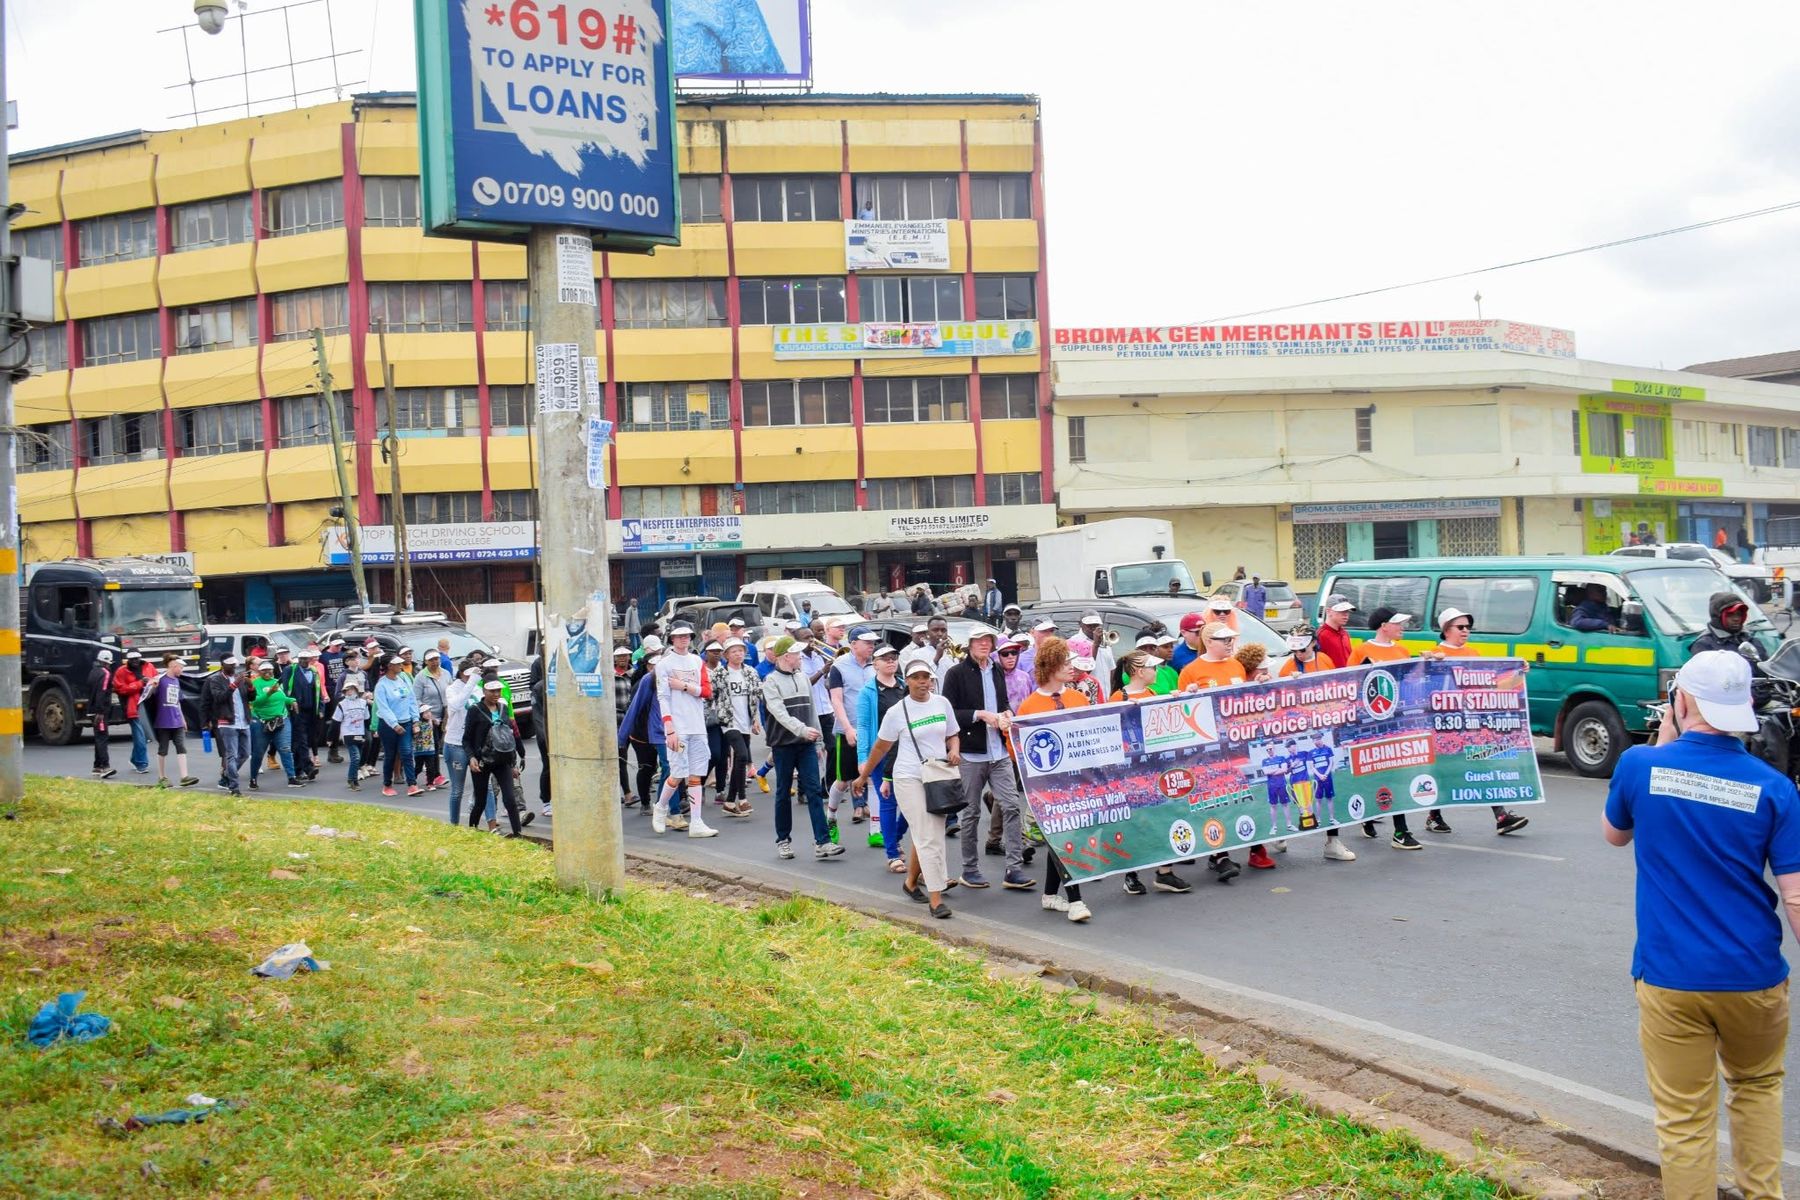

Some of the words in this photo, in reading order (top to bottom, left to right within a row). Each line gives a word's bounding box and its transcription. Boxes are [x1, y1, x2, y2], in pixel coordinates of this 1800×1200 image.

[482, 47, 514, 68] TO
[523, 53, 594, 78] APPLY
[602, 63, 646, 86] FOR
[507, 82, 628, 123] LOANS
[504, 182, 565, 207] 0709
[572, 187, 614, 212] 900
[620, 193, 659, 218] 000
[778, 327, 829, 343] THE
[1055, 328, 1161, 344] BROMAK
[1169, 326, 1215, 342] GEN
[1221, 323, 1373, 342] MERCHANTS
[1061, 344, 1113, 352] SUPPLIERS
[1133, 343, 1167, 351] STEAM
[1272, 340, 1322, 348] STAINLESS
[1326, 339, 1353, 347] PIPES
[1116, 350, 1174, 358] PETROLEUM
[1178, 349, 1212, 357] VALVES
[1276, 347, 1337, 355] SPECIALISTS
[1472, 342, 1500, 350] TOOLS
[1295, 505, 1335, 513] BROMAK
[1336, 503, 1377, 512] GENERAL
[1380, 500, 1437, 510] MERCHANTS
[1464, 499, 1499, 508] LIMITED
[642, 519, 674, 530] NESPETE
[675, 518, 725, 529] ENTERPRISES
[891, 516, 946, 526] FINESALES
[949, 514, 989, 524] LIMITED
[365, 529, 386, 540] TOP
[388, 528, 429, 540] NTCH
[431, 527, 476, 538] DRIVING
[479, 525, 526, 537] SCHOOL
[409, 539, 453, 548] COMPUTER
[454, 537, 492, 546] COLLEGE
[417, 552, 437, 560] 0704
[1453, 669, 1496, 686] Venue:
[1220, 693, 1277, 717] United
[1281, 690, 1295, 708] in
[1301, 682, 1358, 705] making
[1431, 693, 1464, 711] CITY
[1466, 692, 1519, 710] STADIUM
[1229, 725, 1258, 743] our
[1262, 716, 1307, 737] voice
[1312, 705, 1357, 729] heard
[1465, 718, 1480, 729] am
[1066, 725, 1119, 739] INTERNATIONAL
[1069, 747, 1109, 759] AWARENESS
[1110, 744, 1121, 753] DAY
[1359, 739, 1430, 765] ALBINISM
[1361, 764, 1374, 774] DAY
[1374, 755, 1430, 771] TOURNAMENT
[1464, 771, 1494, 782] Guest
[1496, 770, 1519, 781] Team
[1188, 784, 1253, 812] KENYA
[1451, 788, 1482, 801] LION
[1486, 786, 1518, 800] STARS
[1519, 786, 1534, 798] FC
[1045, 797, 1103, 817] Procession
[1105, 791, 1127, 806] Walk
[1042, 813, 1094, 835] SHAURI
[1098, 805, 1131, 825] MOYO
